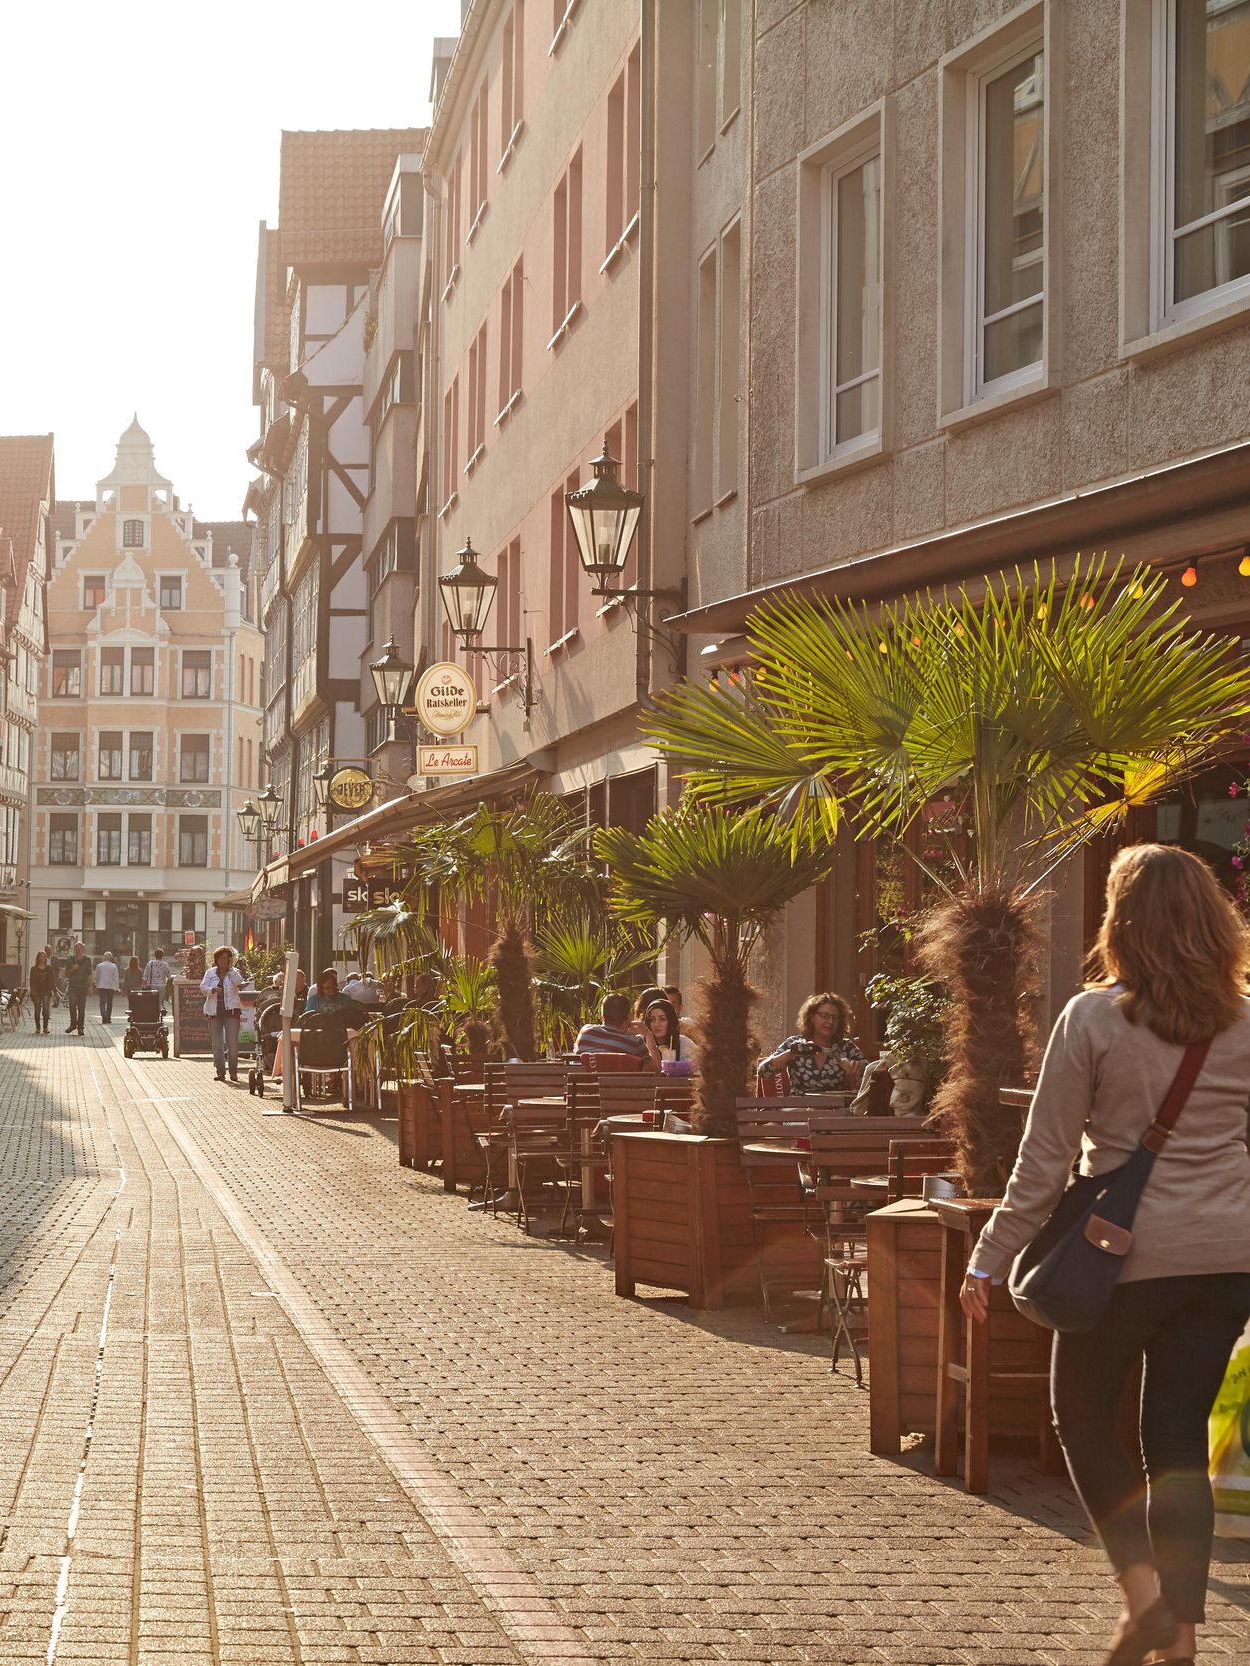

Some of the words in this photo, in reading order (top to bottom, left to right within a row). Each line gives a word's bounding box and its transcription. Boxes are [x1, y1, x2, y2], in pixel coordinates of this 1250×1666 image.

[430, 686, 465, 697] Gilde
[426, 697, 468, 709] Ratskeller
[425, 754, 439, 768] Le
[347, 886, 368, 902] sk
